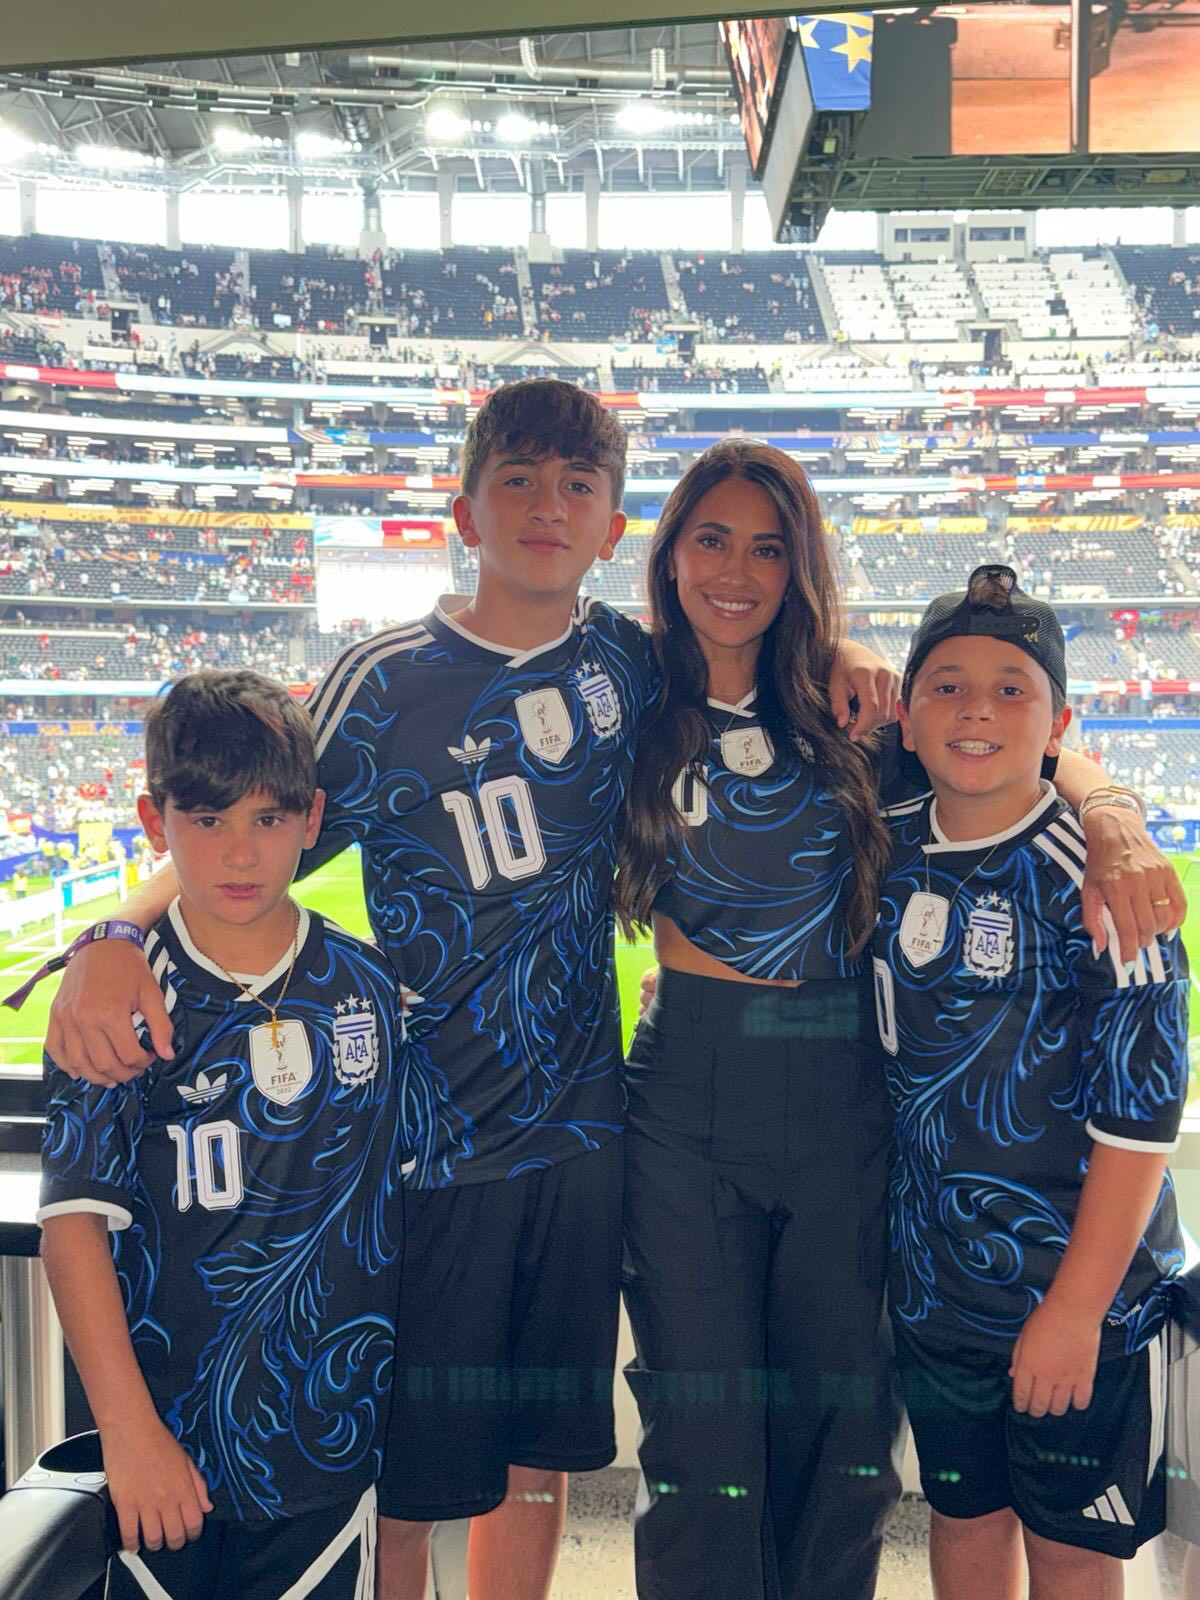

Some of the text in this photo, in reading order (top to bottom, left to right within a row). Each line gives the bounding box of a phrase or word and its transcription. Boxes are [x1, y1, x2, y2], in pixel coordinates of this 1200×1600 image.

[540, 734, 561, 747] FIFA
[740, 758, 762, 767] FIFA
[441, 775, 547, 891] 10
[911, 937, 931, 950] FIFA
[975, 929, 1001, 959] AFA
[345, 1034, 369, 1063] AFA
[271, 1071, 297, 1085] FIFA
[166, 1120, 244, 1212] 10
